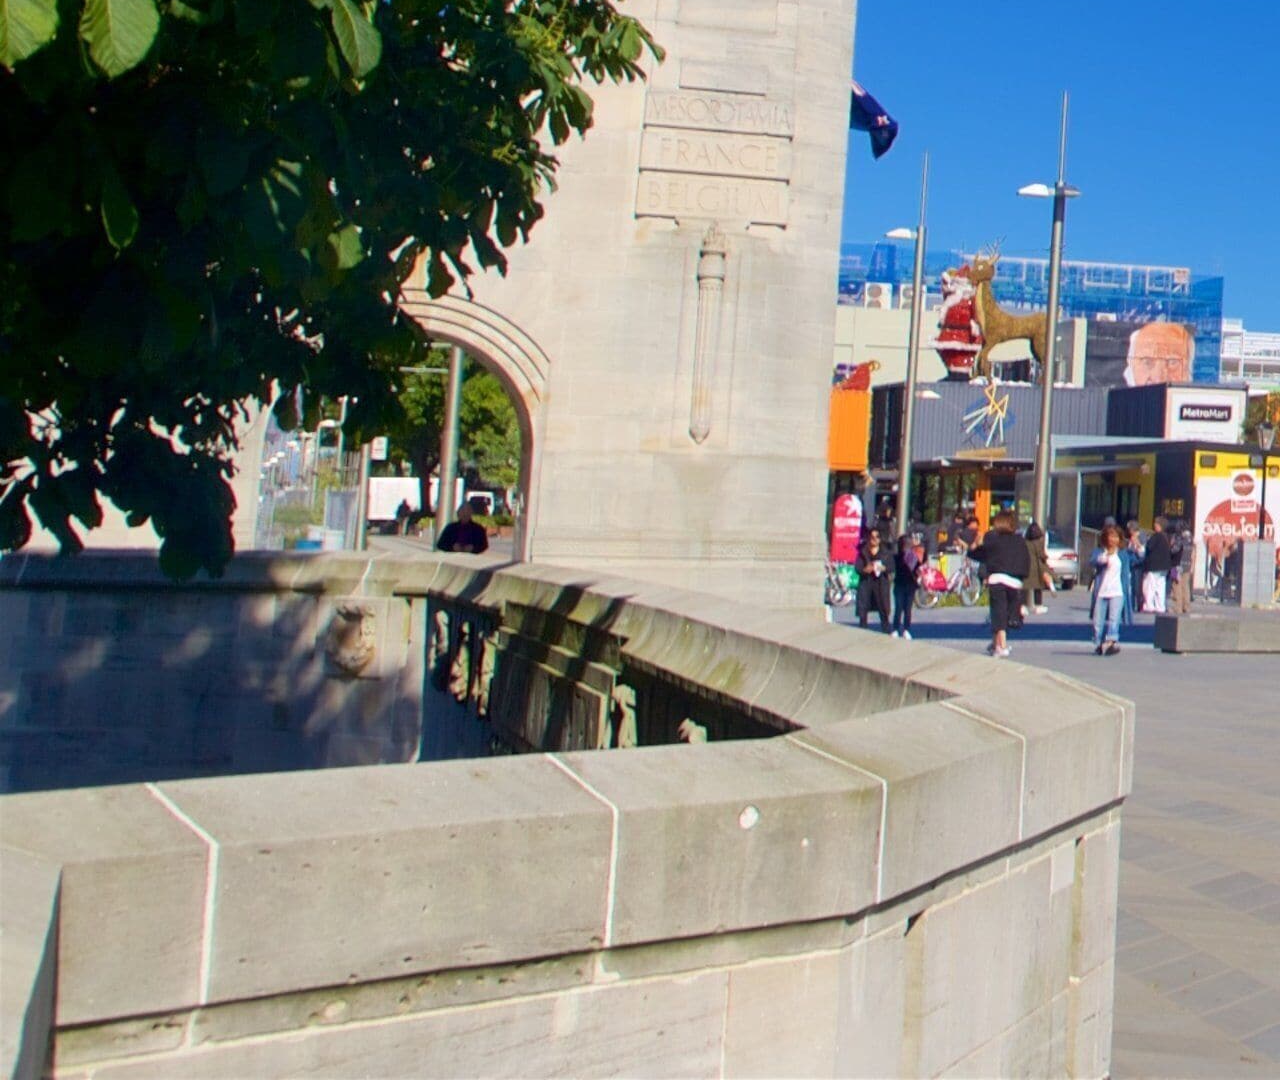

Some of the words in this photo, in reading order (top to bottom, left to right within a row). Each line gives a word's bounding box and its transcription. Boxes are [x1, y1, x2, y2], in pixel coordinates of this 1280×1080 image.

[648, 94, 791, 131] MESOPOTAMIA
[660, 137, 777, 172] FRANCE
[647, 180, 780, 216] BELGIUM
[1182, 407, 1229, 420] MetroMart
